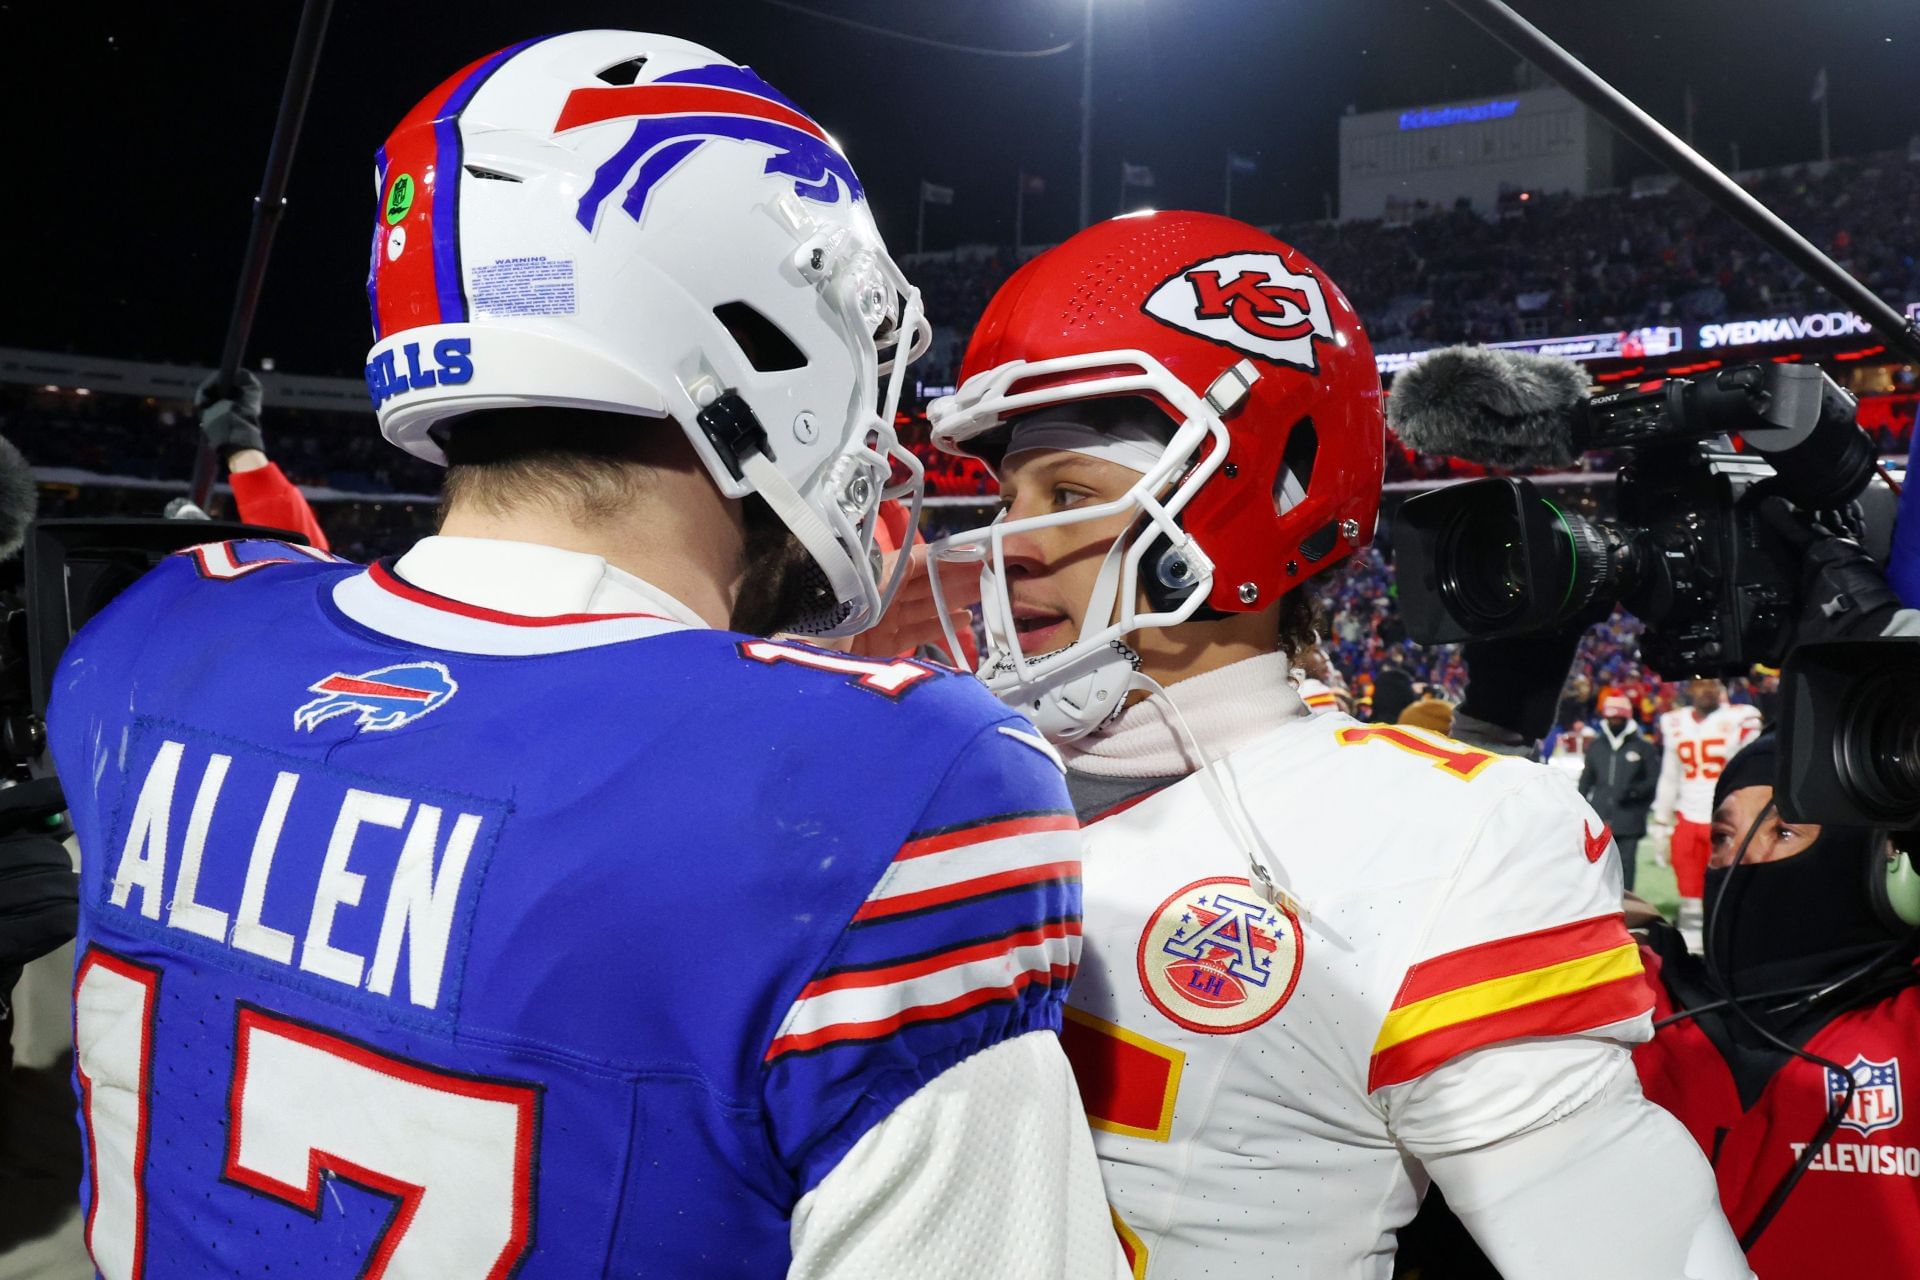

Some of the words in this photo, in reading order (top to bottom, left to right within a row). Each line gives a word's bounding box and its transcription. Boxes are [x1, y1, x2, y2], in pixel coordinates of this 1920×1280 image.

[495, 256, 547, 264] WARNING
[1184, 270, 1315, 341] KC
[1590, 393, 1620, 405] SONY
[1676, 738, 1727, 779] 95
[107, 740, 483, 1010] ALLEN
[1188, 969, 1225, 997] LH
[74, 940, 548, 1280] 17
